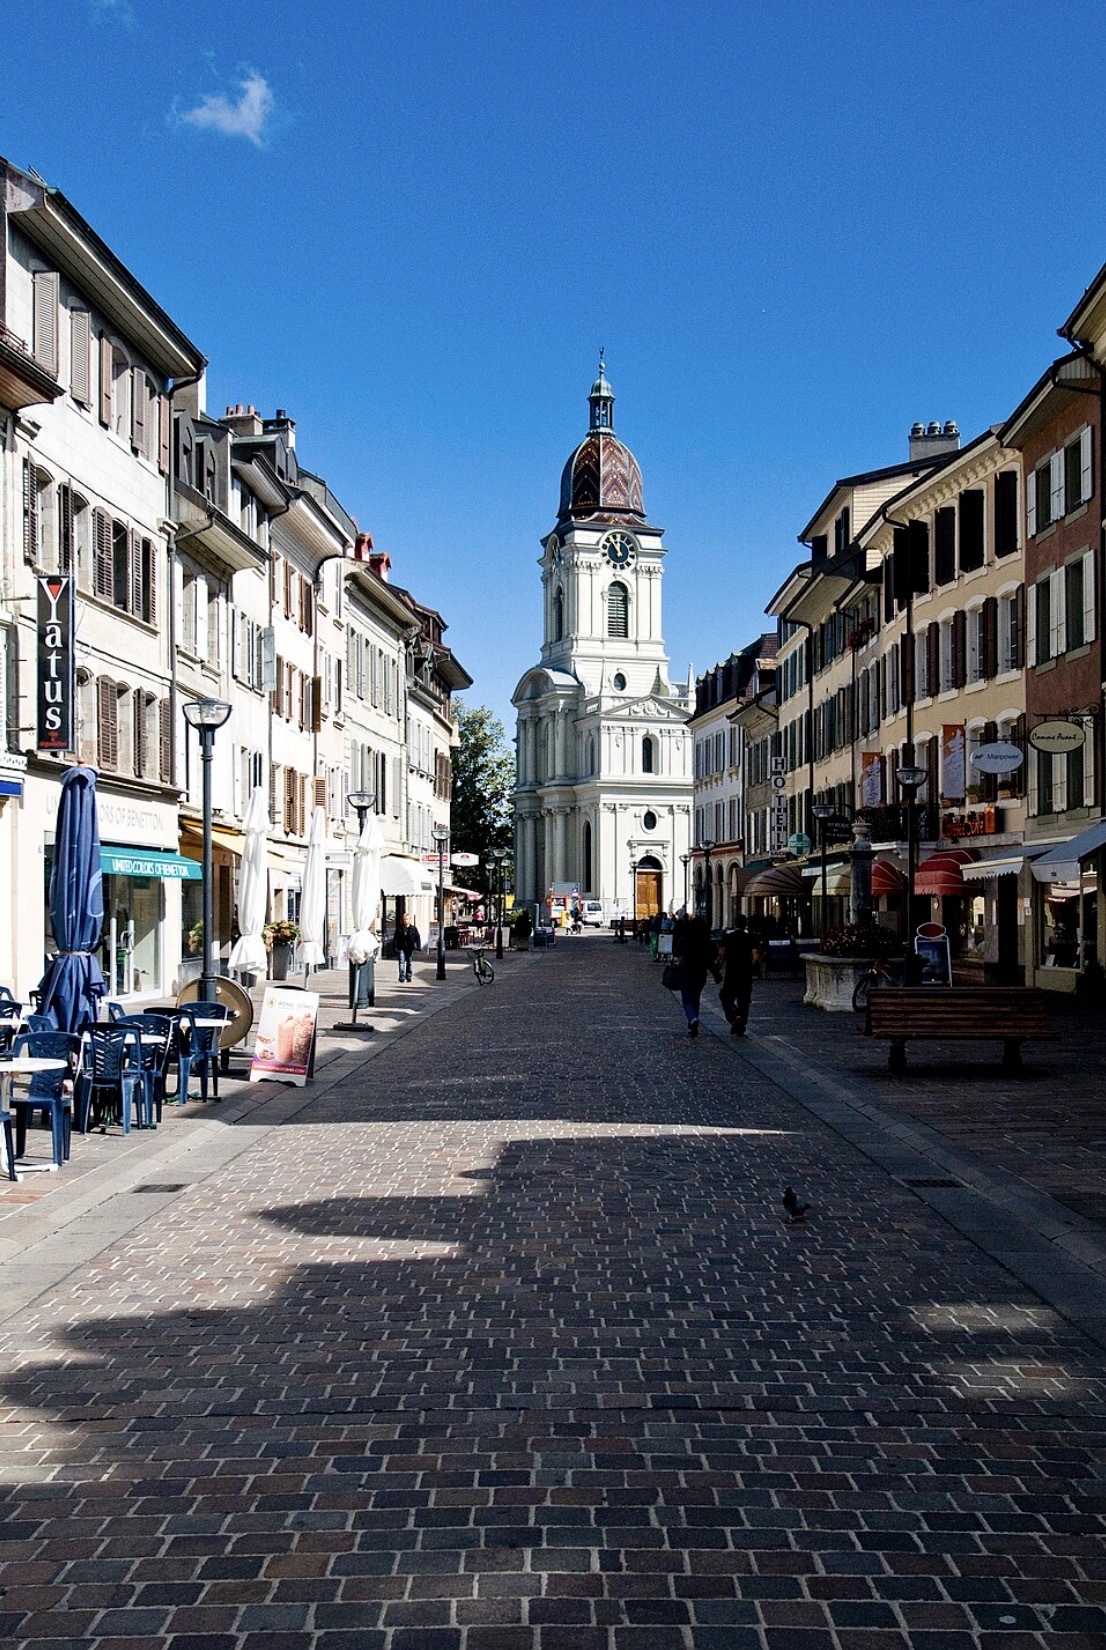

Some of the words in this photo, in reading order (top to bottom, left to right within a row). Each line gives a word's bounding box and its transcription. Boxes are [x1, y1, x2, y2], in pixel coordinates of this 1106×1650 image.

[38, 577, 70, 730] Yatus
[987, 753, 1019, 761] Manpower
[773, 758, 786, 845] HOTEL
[127, 809, 164, 831] BENETTON
[112, 859, 133, 872] UNITED
[132, 860, 155, 875] COLORS
[154, 862, 163, 875] OF
[162, 863, 190, 877] BENETTON
